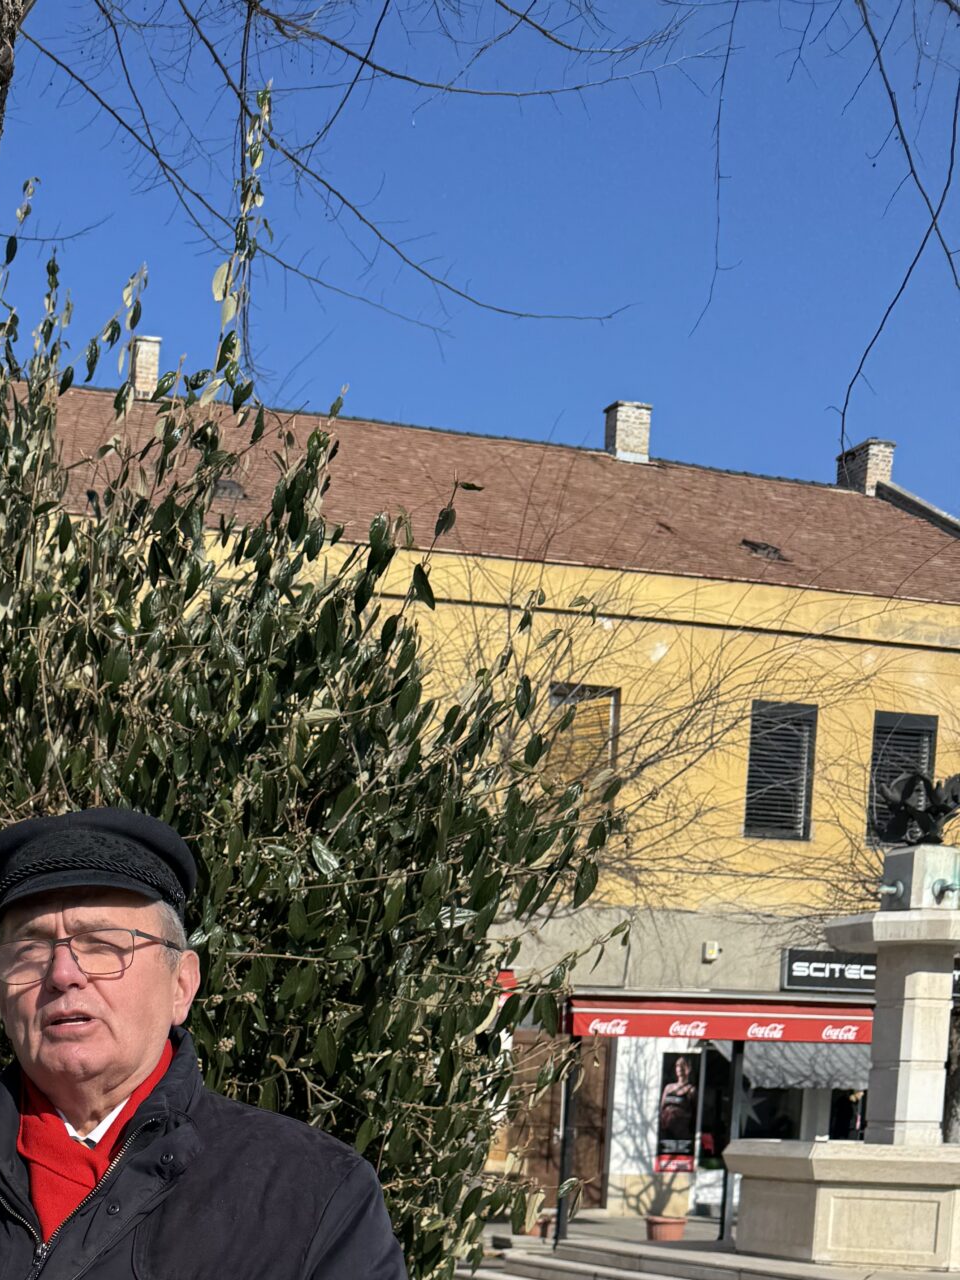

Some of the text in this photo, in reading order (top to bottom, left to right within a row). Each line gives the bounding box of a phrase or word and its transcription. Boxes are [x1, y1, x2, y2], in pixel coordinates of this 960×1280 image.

[792, 961, 877, 980] SCITEC
[588, 1018, 859, 1040] Coca-Cola Coca-Cola Coca-Cola Coca-Cola
